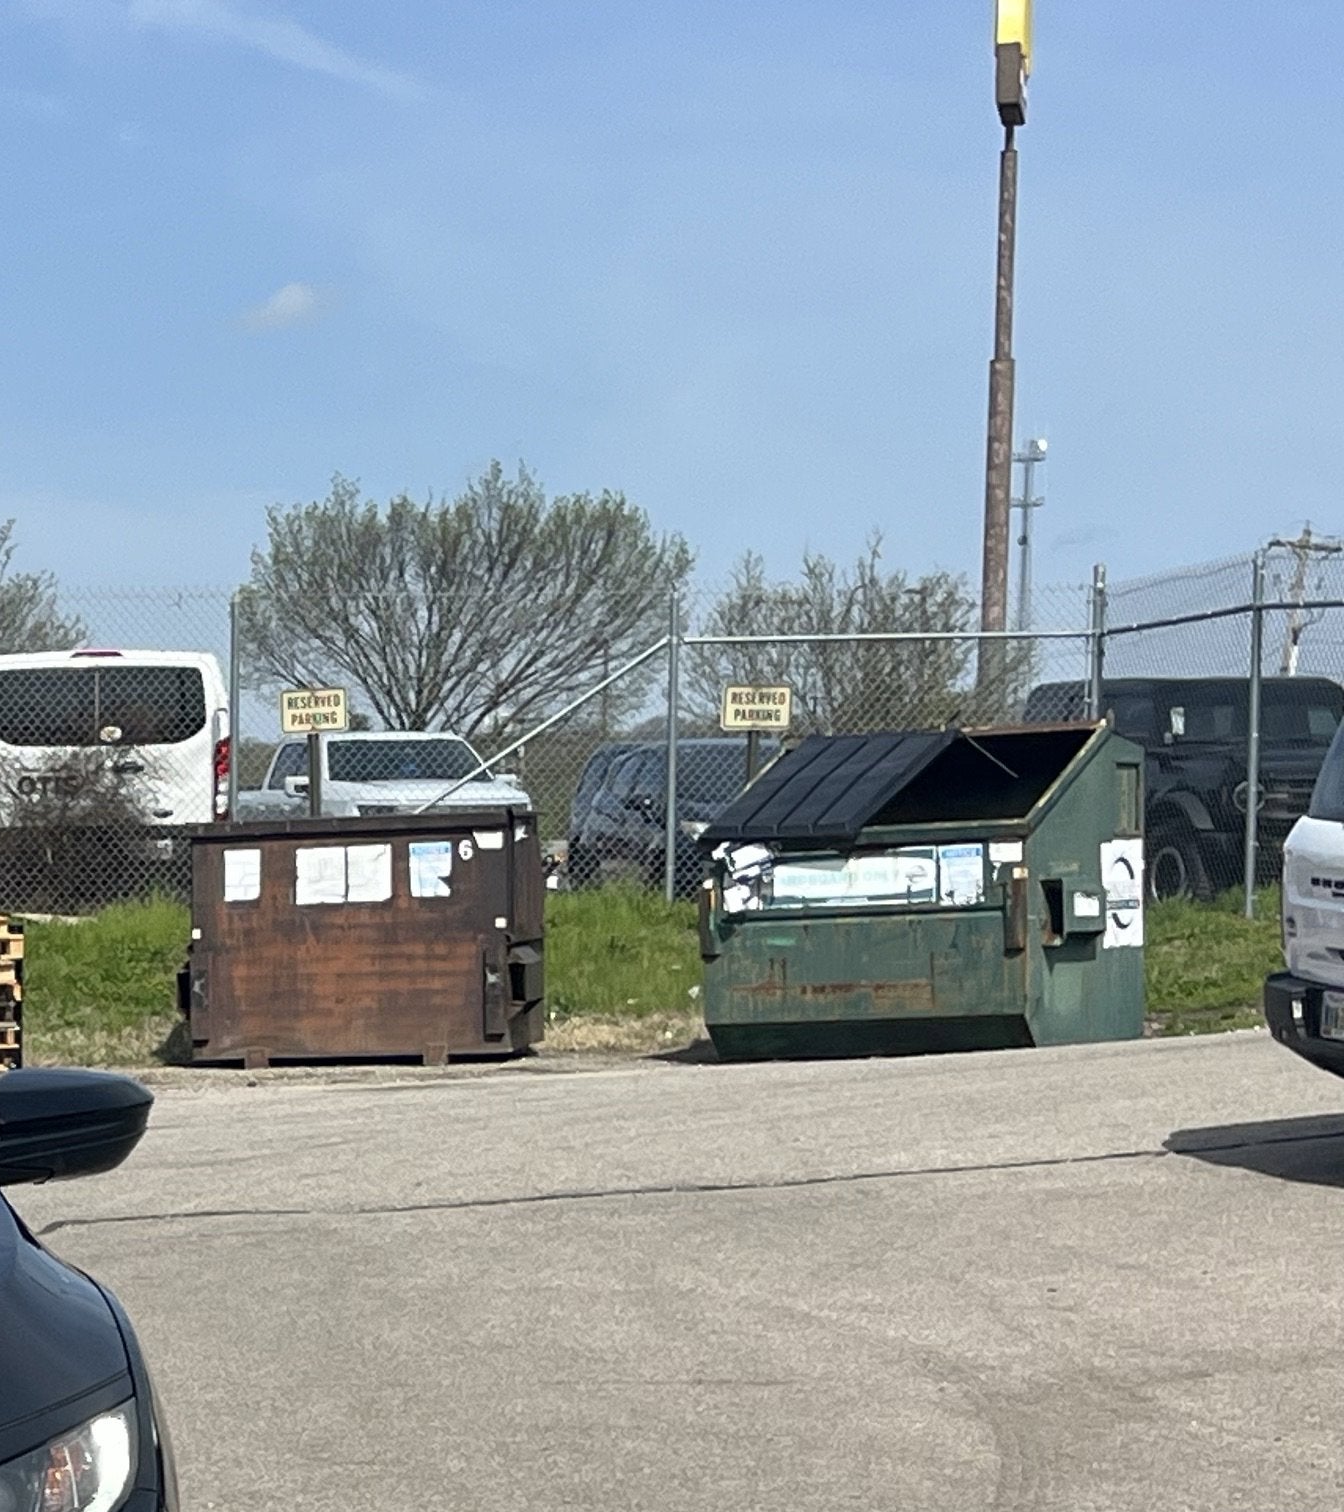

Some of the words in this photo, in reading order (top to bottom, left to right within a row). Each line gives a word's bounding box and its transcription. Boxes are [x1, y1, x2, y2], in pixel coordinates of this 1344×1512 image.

[287, 694, 341, 710] RESERVED
[731, 692, 786, 705] RESERVED
[291, 711, 338, 726] PARKING
[734, 709, 781, 721] PARKING
[459, 839, 473, 860] 6
